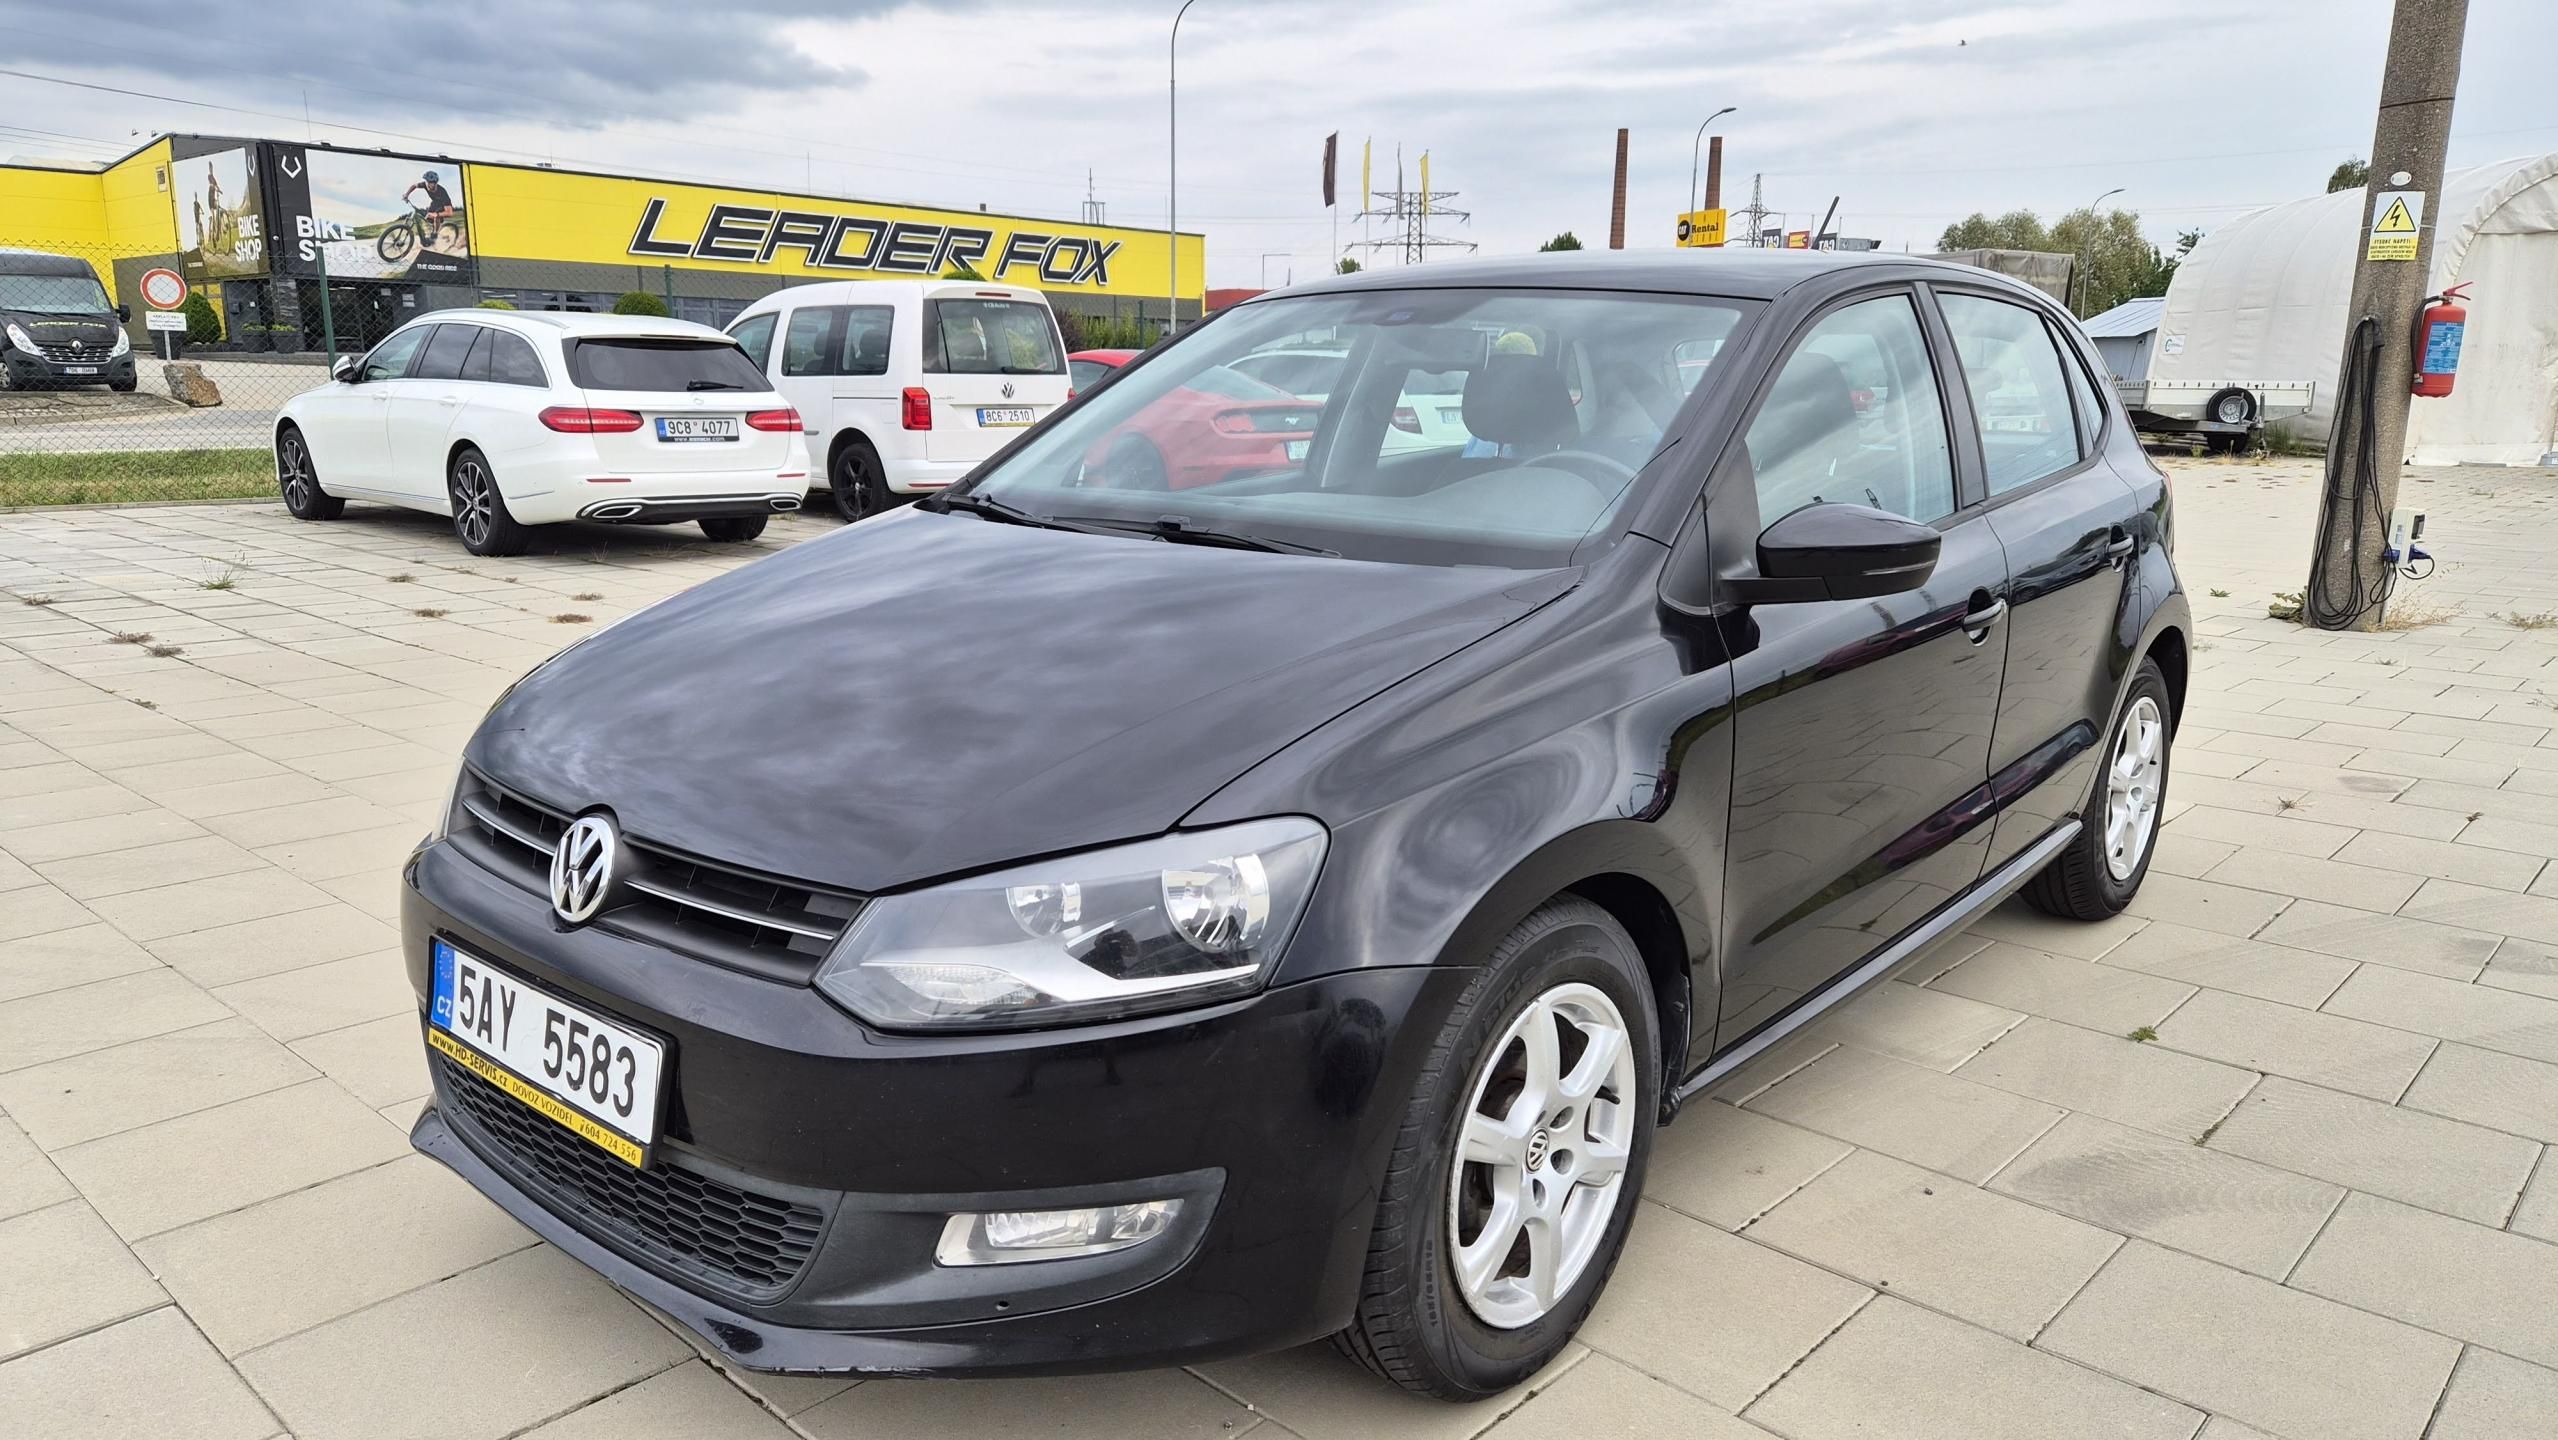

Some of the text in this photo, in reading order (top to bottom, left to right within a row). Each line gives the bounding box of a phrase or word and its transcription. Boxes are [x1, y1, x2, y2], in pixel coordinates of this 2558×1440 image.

[237, 214, 260, 238] BIKE
[296, 215, 356, 241] BIKE
[1691, 222, 1719, 234] Rental
[234, 239, 262, 262] SHOP
[627, 196, 1123, 286] LEADER FOX
[668, 421, 731, 435] 9C8 4077
[986, 410, 1030, 422] 8C6 2510
[437, 995, 452, 1019] CZ
[459, 963, 636, 1118] 5AY 5583
[432, 1033, 637, 1161] www.HD-SERVIS.cz DOVOZ VOZIDEL 604 724 556
